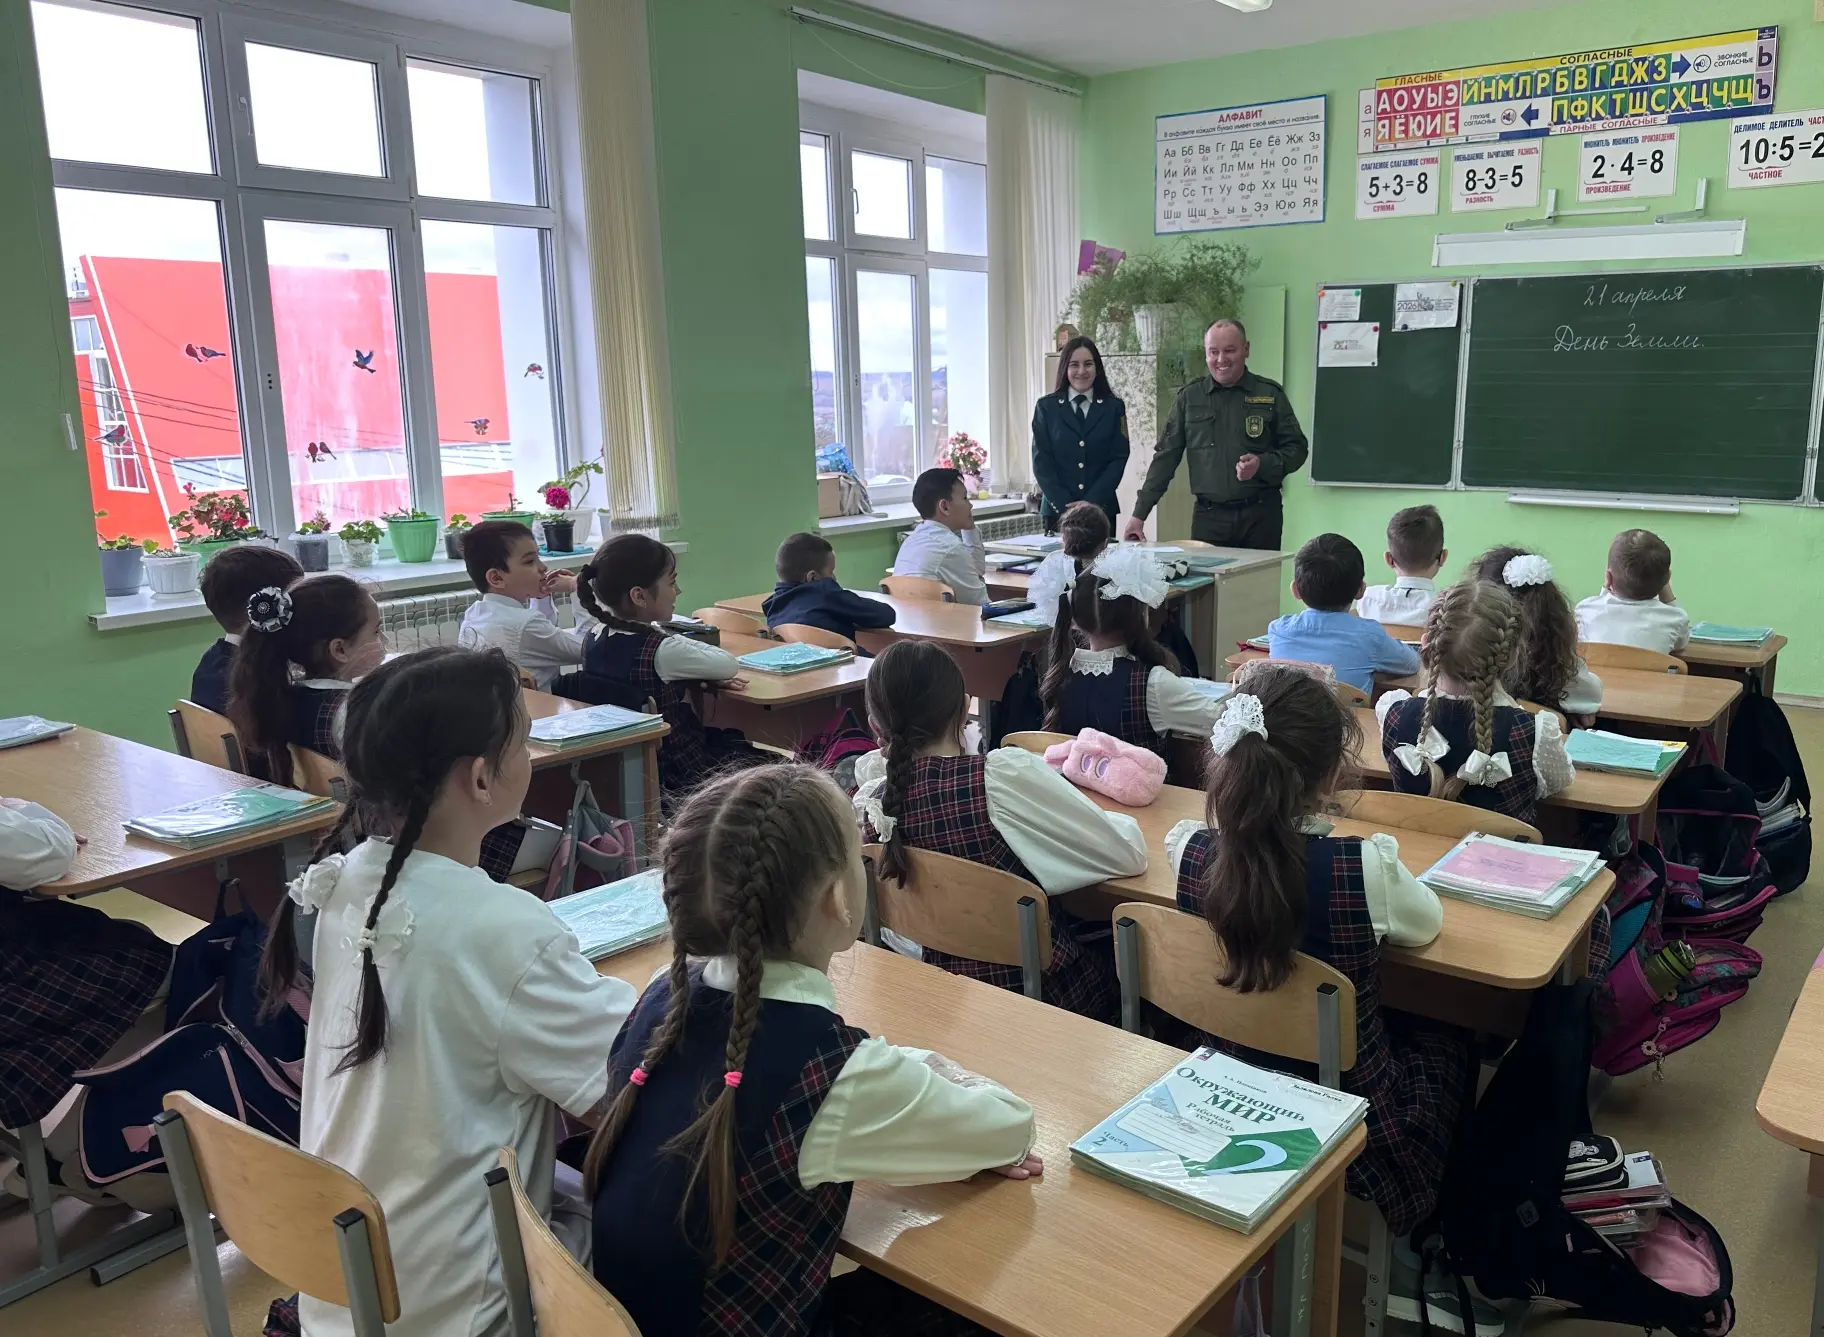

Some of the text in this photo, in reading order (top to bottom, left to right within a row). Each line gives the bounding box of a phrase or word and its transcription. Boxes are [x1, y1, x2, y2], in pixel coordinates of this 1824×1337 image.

[1560, 48, 1633, 65] СОГЛАСНЫЕ
[1713, 57, 1754, 67] СОГЛАСНЫЕ
[1717, 51, 1748, 60] ЗВОНКИЕ
[1394, 72, 1443, 86] ГЛАСНЫЕ
[1217, 109, 1263, 123] АЛФАВИТ
[1464, 118, 1497, 126] СОГЛАСНЫЕ
[1560, 116, 1658, 133] ПАРНЫЕ СОГЛАСНЫЕ
[1733, 122, 1766, 134] ДЕЛИМОЕ
[1769, 118, 1804, 130] ДЕЛИТЕЛЬ
[1164, 131, 1320, 158] Аа Бб Вв Гг Дд Ее Ёё Жж Зз
[1641, 132, 1676, 143] ПРОИЗВЕДЕНИЕ
[1517, 146, 1539, 156] РАЗНОСТЬ
[1164, 154, 1318, 178] Ии Йй Кк Лл Мм Нн Оо Пп
[1361, 156, 1439, 171] СЛАГАЕМОЕ СЛАГАЕМОЕ СУММА
[1748, 169, 1783, 180] ЧАСТНОЕ
[1164, 176, 1318, 201] Рр Сс Тт Уу Фф Хх Цц Чч
[1585, 183, 1631, 195] ПРОИЗВЕДЕНИЕ
[1465, 195, 1494, 204] РАЗНОСТЬ
[1163, 209, 1181, 219] Шш
[1188, 207, 1206, 219] Щщ
[1254, 201, 1269, 212] Ээ
[1275, 199, 1296, 210] Юю
[1303, 197, 1318, 207] Яя
[1372, 204, 1395, 213] СУММА
[1397, 302, 1417, 310] 2026
[1583, 284, 1687, 316] 21 апреля
[1553, 325, 1609, 352] День
[1176, 1067, 1305, 1122] Окружающий
[1186, 1102, 1232, 1124] Рабочая
[1201, 1092, 1277, 1125] МИР
[1195, 1113, 1235, 1132] тетрадь
[1092, 1136, 1108, 1147] 2
[1103, 1131, 1129, 1147] Часть
